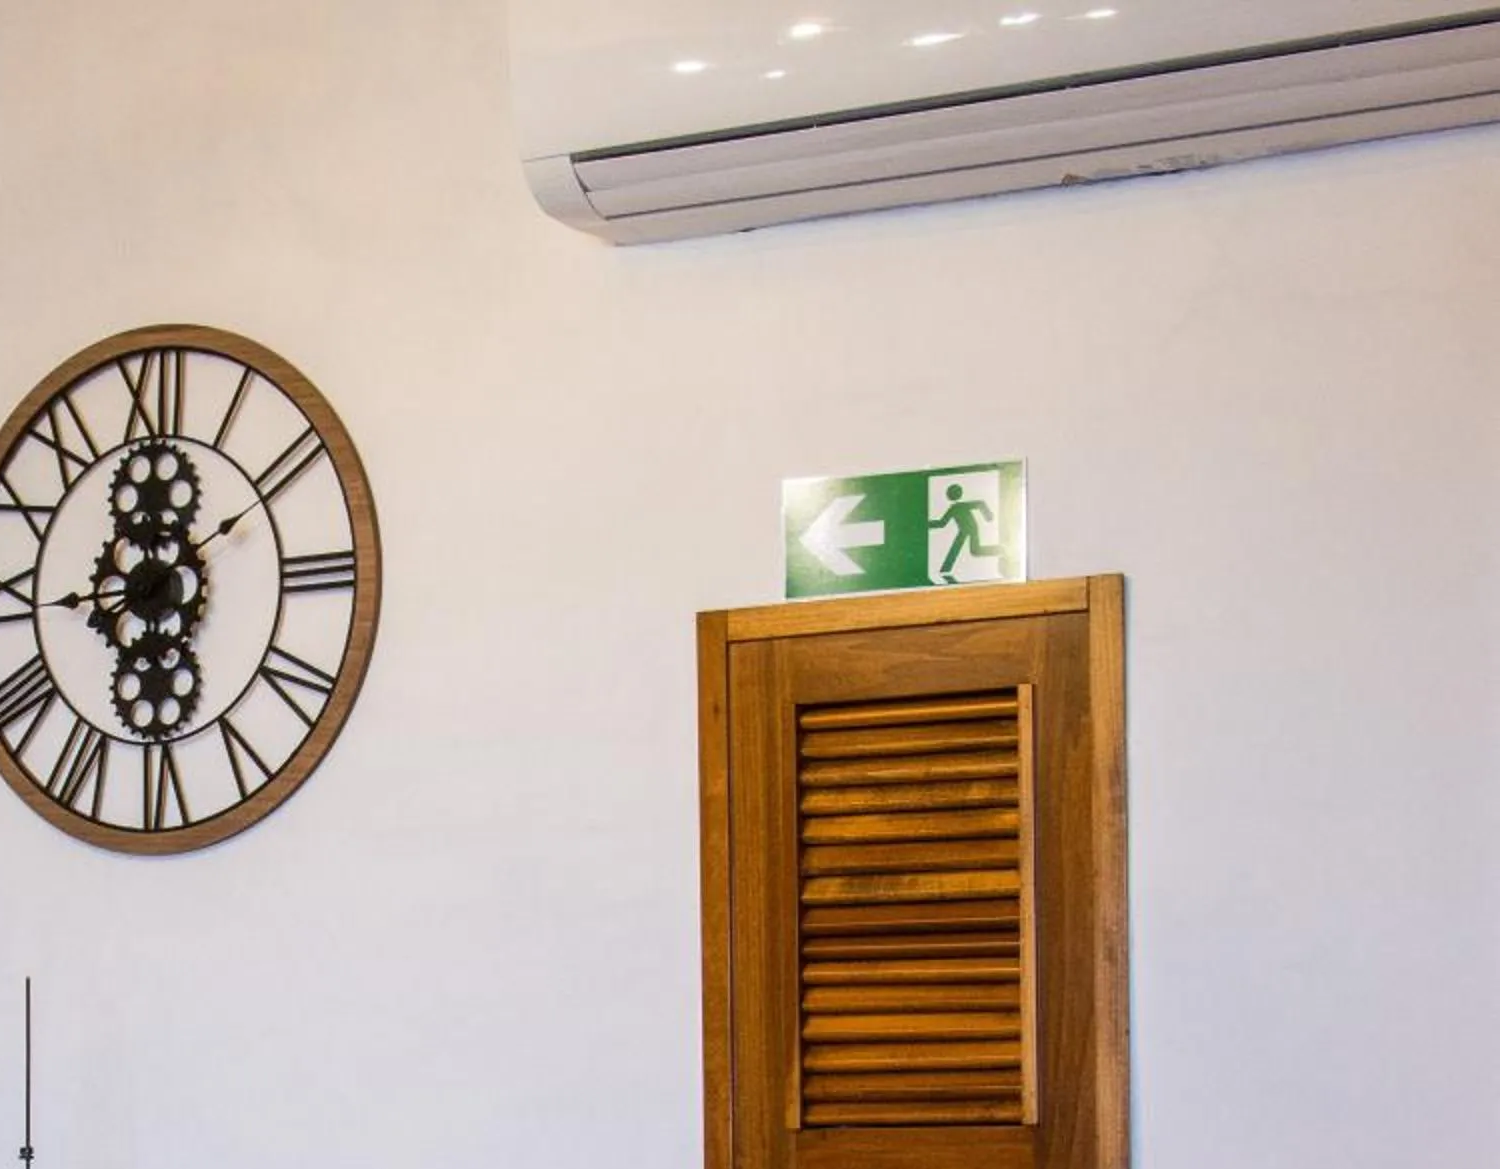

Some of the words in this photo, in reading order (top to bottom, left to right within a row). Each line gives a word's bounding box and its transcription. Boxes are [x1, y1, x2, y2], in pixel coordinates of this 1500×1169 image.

[116, 351, 182, 442] XII
[27, 393, 100, 491] XI
[253, 425, 327, 501] II
[281, 550, 354, 592] III
[259, 645, 336, 729] IV
[45, 717, 106, 819] VII
[143, 742, 190, 831] VI
[218, 715, 274, 800] V
